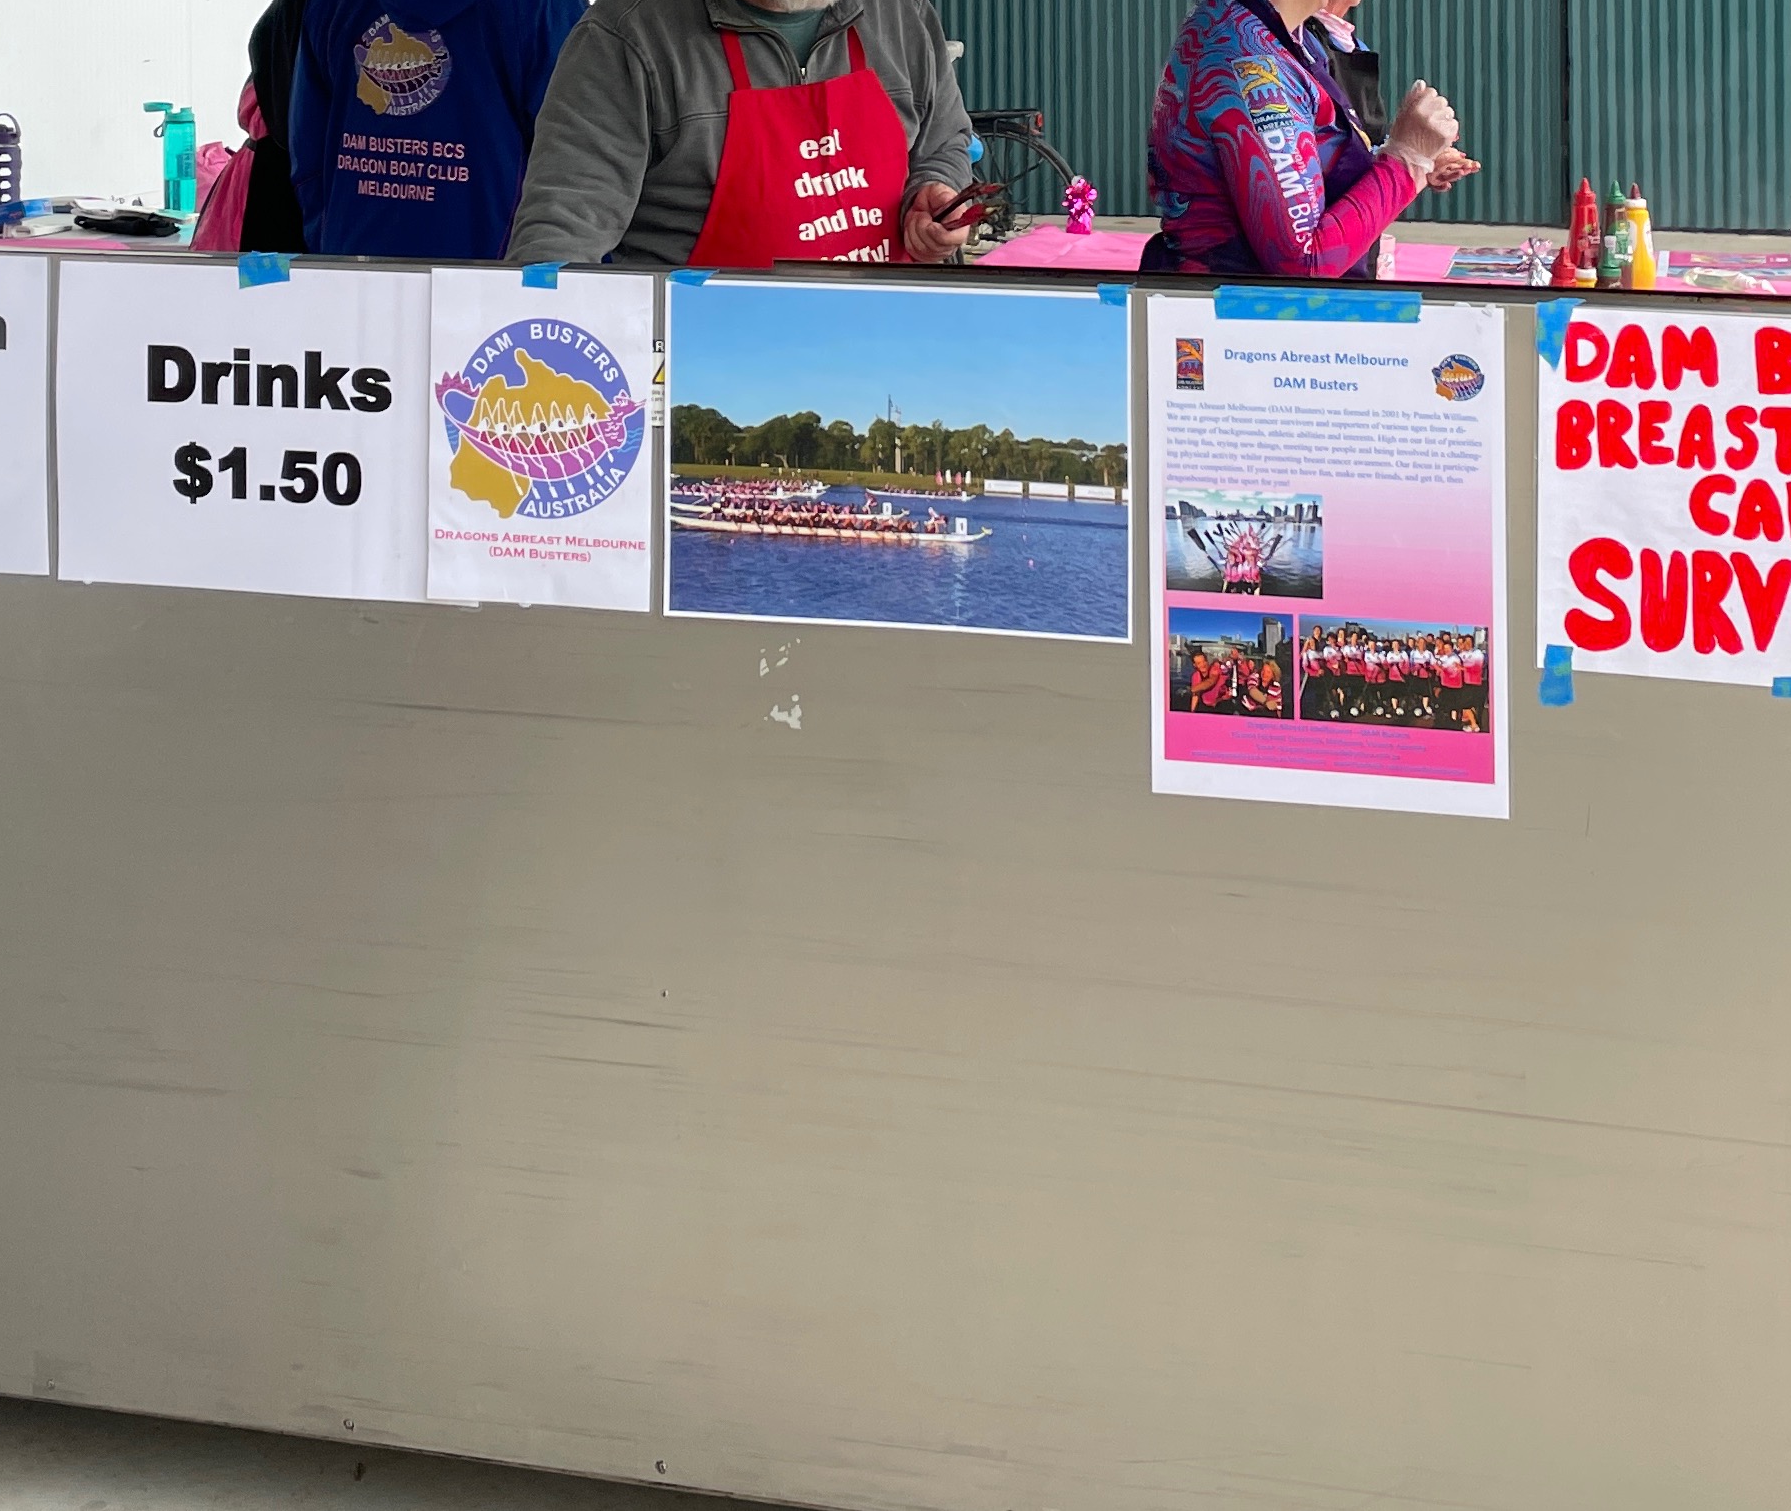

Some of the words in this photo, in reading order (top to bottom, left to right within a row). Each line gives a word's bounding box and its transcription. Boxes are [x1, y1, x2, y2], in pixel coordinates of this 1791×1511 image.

[369, 14, 390, 37] DAM
[386, 89, 440, 116] AUSTRALIA
[343, 133, 366, 150] DAM
[369, 137, 428, 156] BUSTERS
[433, 142, 465, 160] BCS
[338, 155, 387, 176] DRAGON
[390, 161, 423, 178] BOAT
[427, 164, 470, 182] CLUB
[1262, 130, 1305, 199] DAM
[358, 180, 435, 202] MELBOURNE
[794, 166, 869, 198] drink
[798, 208, 848, 241] and
[852, 206, 882, 228] be
[472, 332, 513, 374] DAM
[530, 323, 619, 383] BUSTERS
[1224, 348, 1276, 365] Dragons
[1280, 350, 1331, 365] Abreast
[1335, 352, 1408, 367] Melbourne
[1564, 322, 1719, 391] DAM
[147, 345, 392, 413] Drinks
[1273, 376, 1305, 389] DAM
[1309, 378, 1358, 391] Busters
[173, 442, 362, 504] $1.50
[524, 468, 627, 518] AUSTRALIA
[489, 547, 526, 560] (DAM
